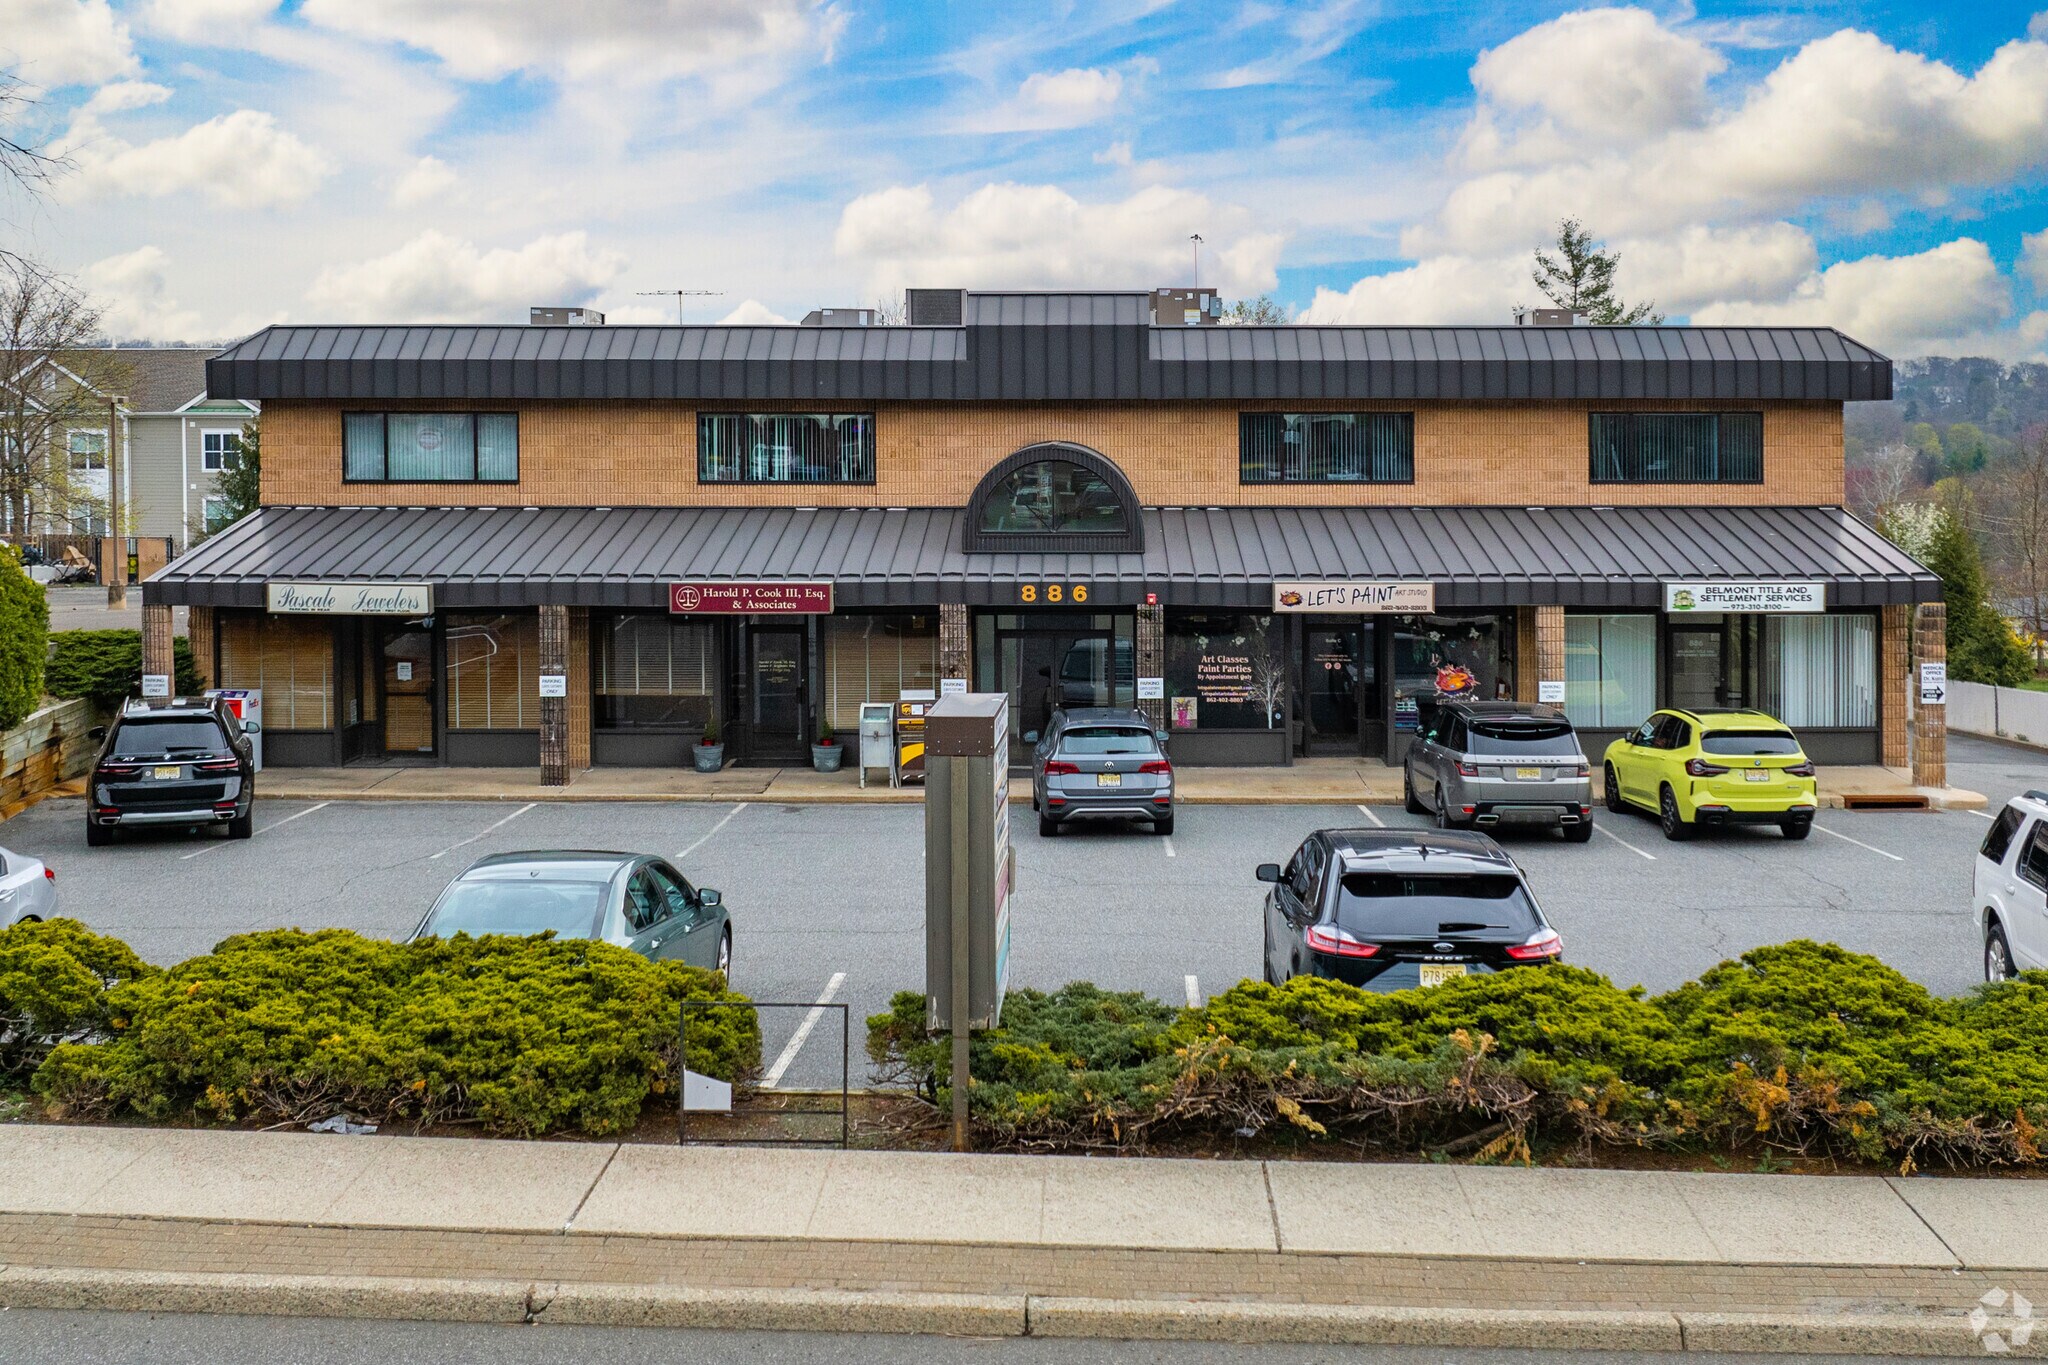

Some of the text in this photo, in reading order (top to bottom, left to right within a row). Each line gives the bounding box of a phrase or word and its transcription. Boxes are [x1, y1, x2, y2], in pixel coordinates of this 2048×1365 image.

[703, 588, 826, 600] Harold P. Cook III, Esq.
[1021, 584, 1088, 602] 886
[1395, 588, 1428, 597] ART STUDIO
[1705, 586, 1808, 594] BELMONT TITLE AND
[278, 585, 420, 610] Pascale Jewelers
[1307, 585, 1397, 606] LET'S PAINT
[1700, 594, 1812, 602] SETTLEMENT SERVICES
[732, 599, 797, 609] & Associates
[1201, 655, 1249, 663] Art Classes
[1198, 664, 1252, 673] Paint Parties
